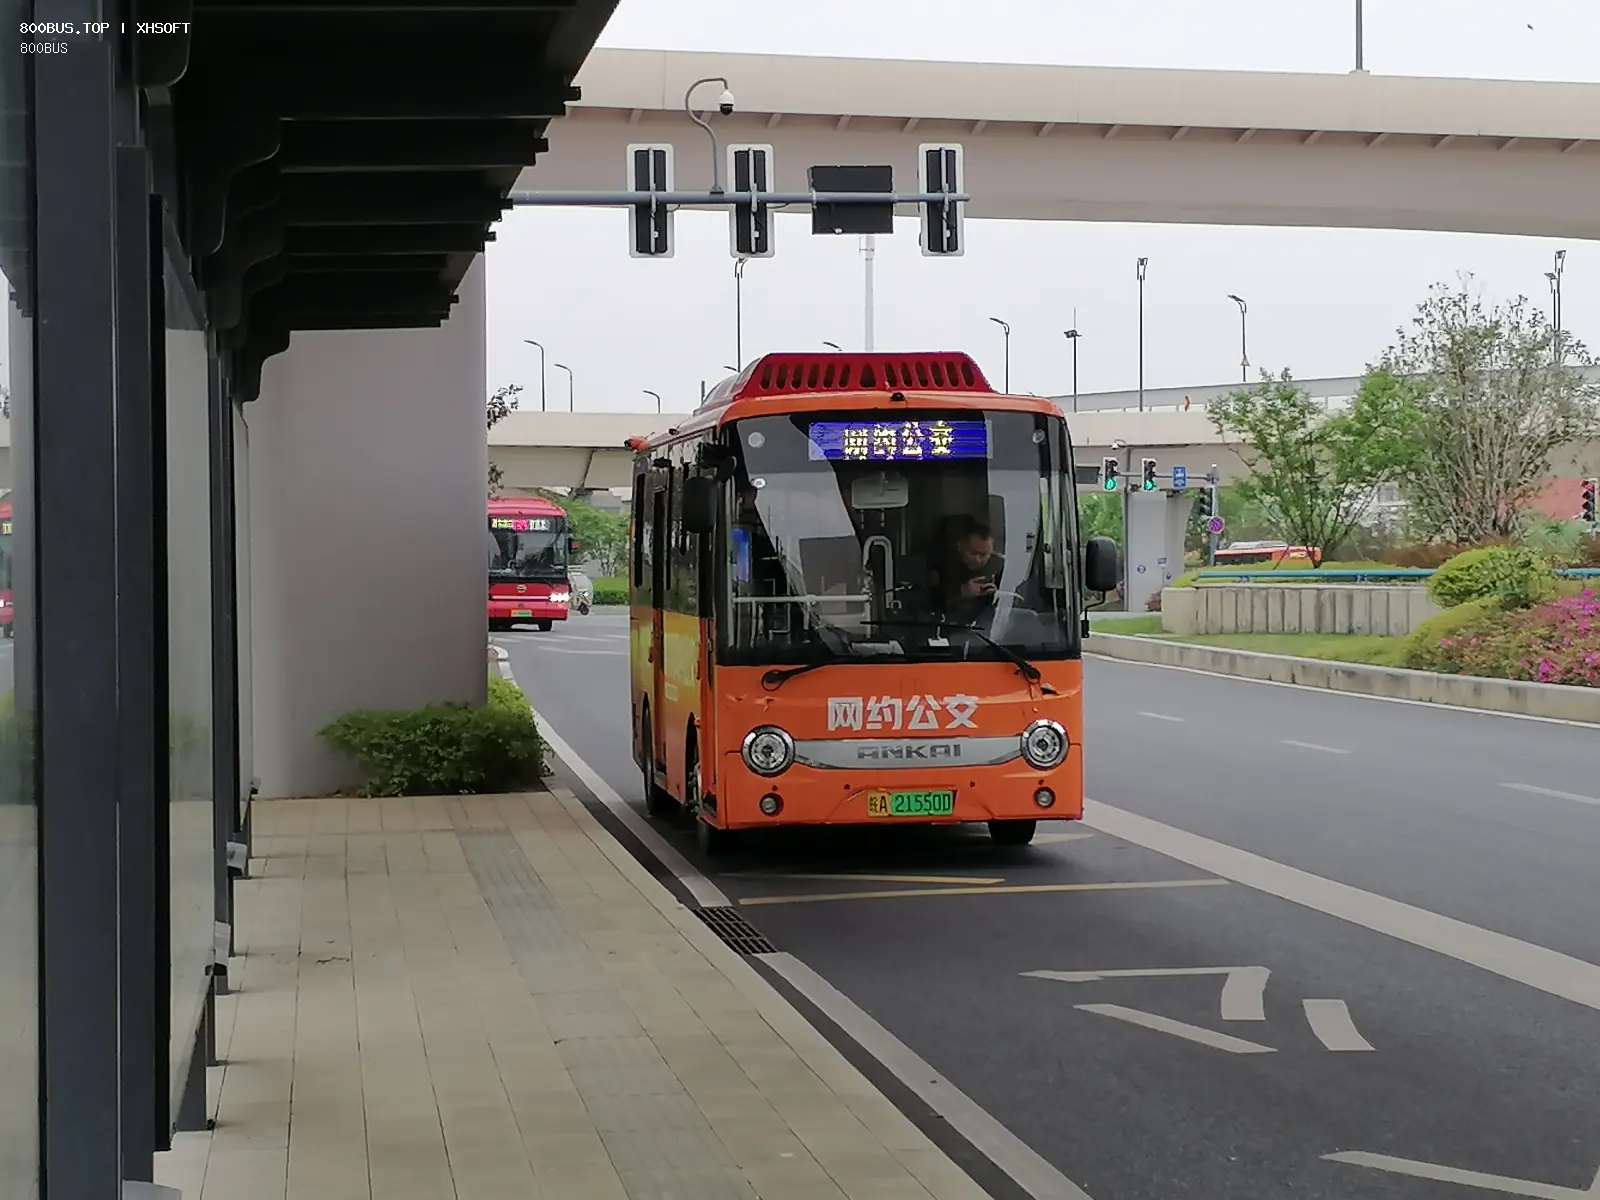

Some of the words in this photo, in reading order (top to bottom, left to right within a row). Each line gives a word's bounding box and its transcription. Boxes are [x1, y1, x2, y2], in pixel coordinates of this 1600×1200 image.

[828, 695, 979, 732] 网约公交
[857, 744, 962, 760] ANKAI
